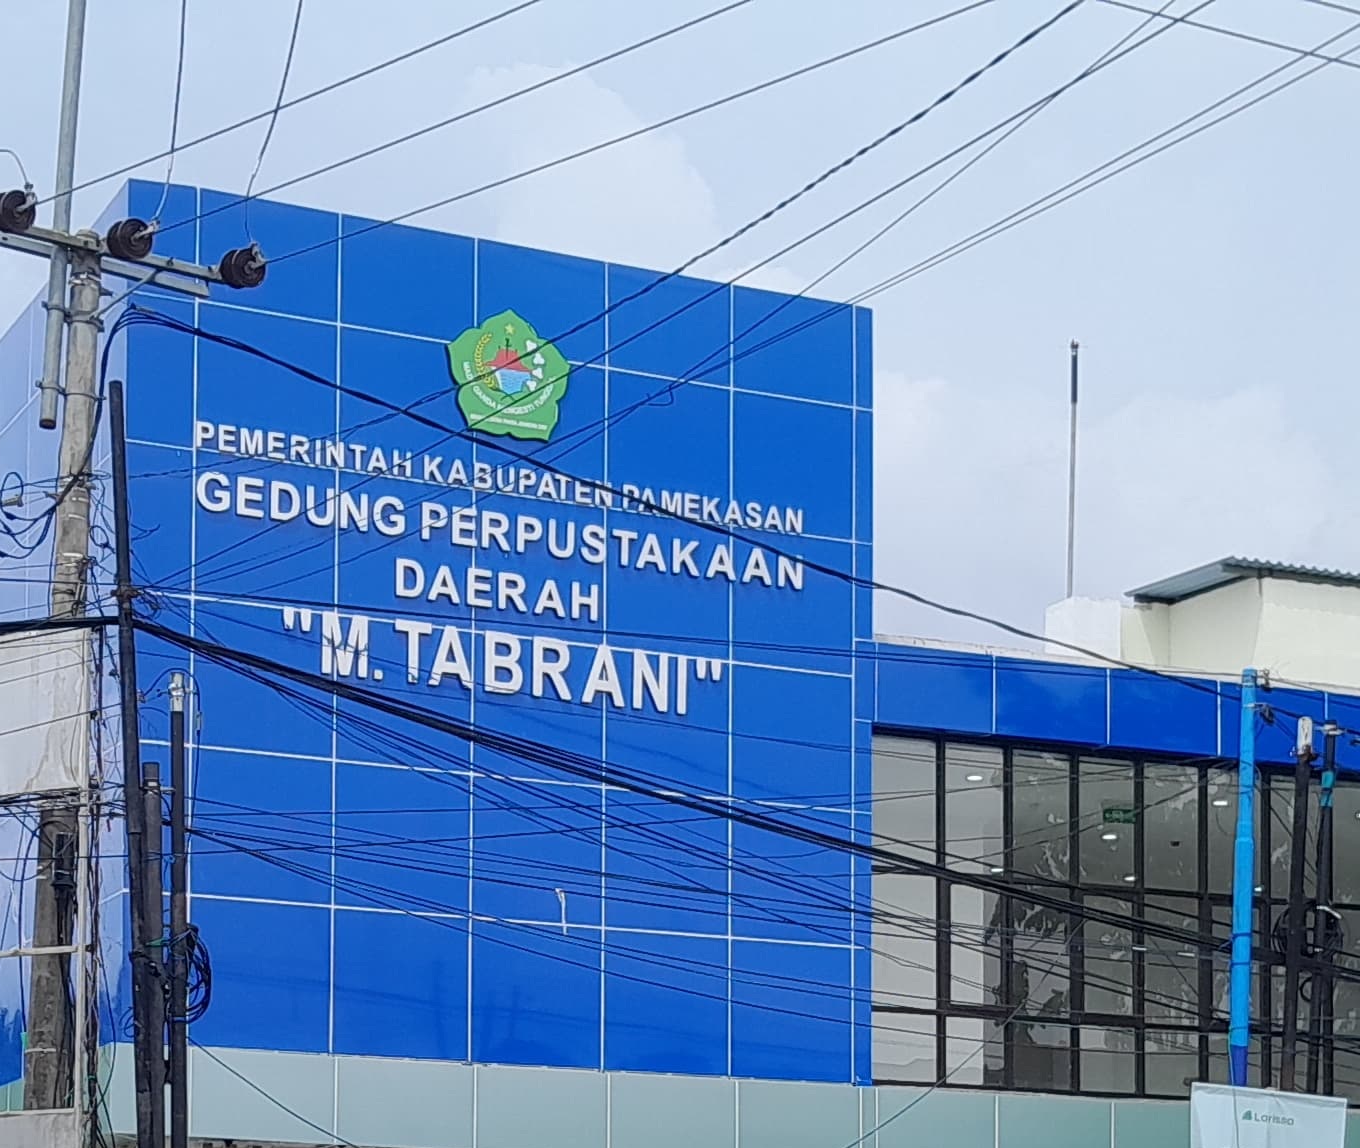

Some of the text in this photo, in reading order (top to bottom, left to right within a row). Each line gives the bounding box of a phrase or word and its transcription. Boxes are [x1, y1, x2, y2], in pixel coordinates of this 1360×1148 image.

[196, 420, 804, 534] PEMERINTAH KABUPATEN PAMEKASAN
[196, 472, 804, 591] GEDUNG PERPUSTAKAAN
[395, 558, 600, 622] DAERAH
[282, 606, 723, 716] "M. TABRANI"
